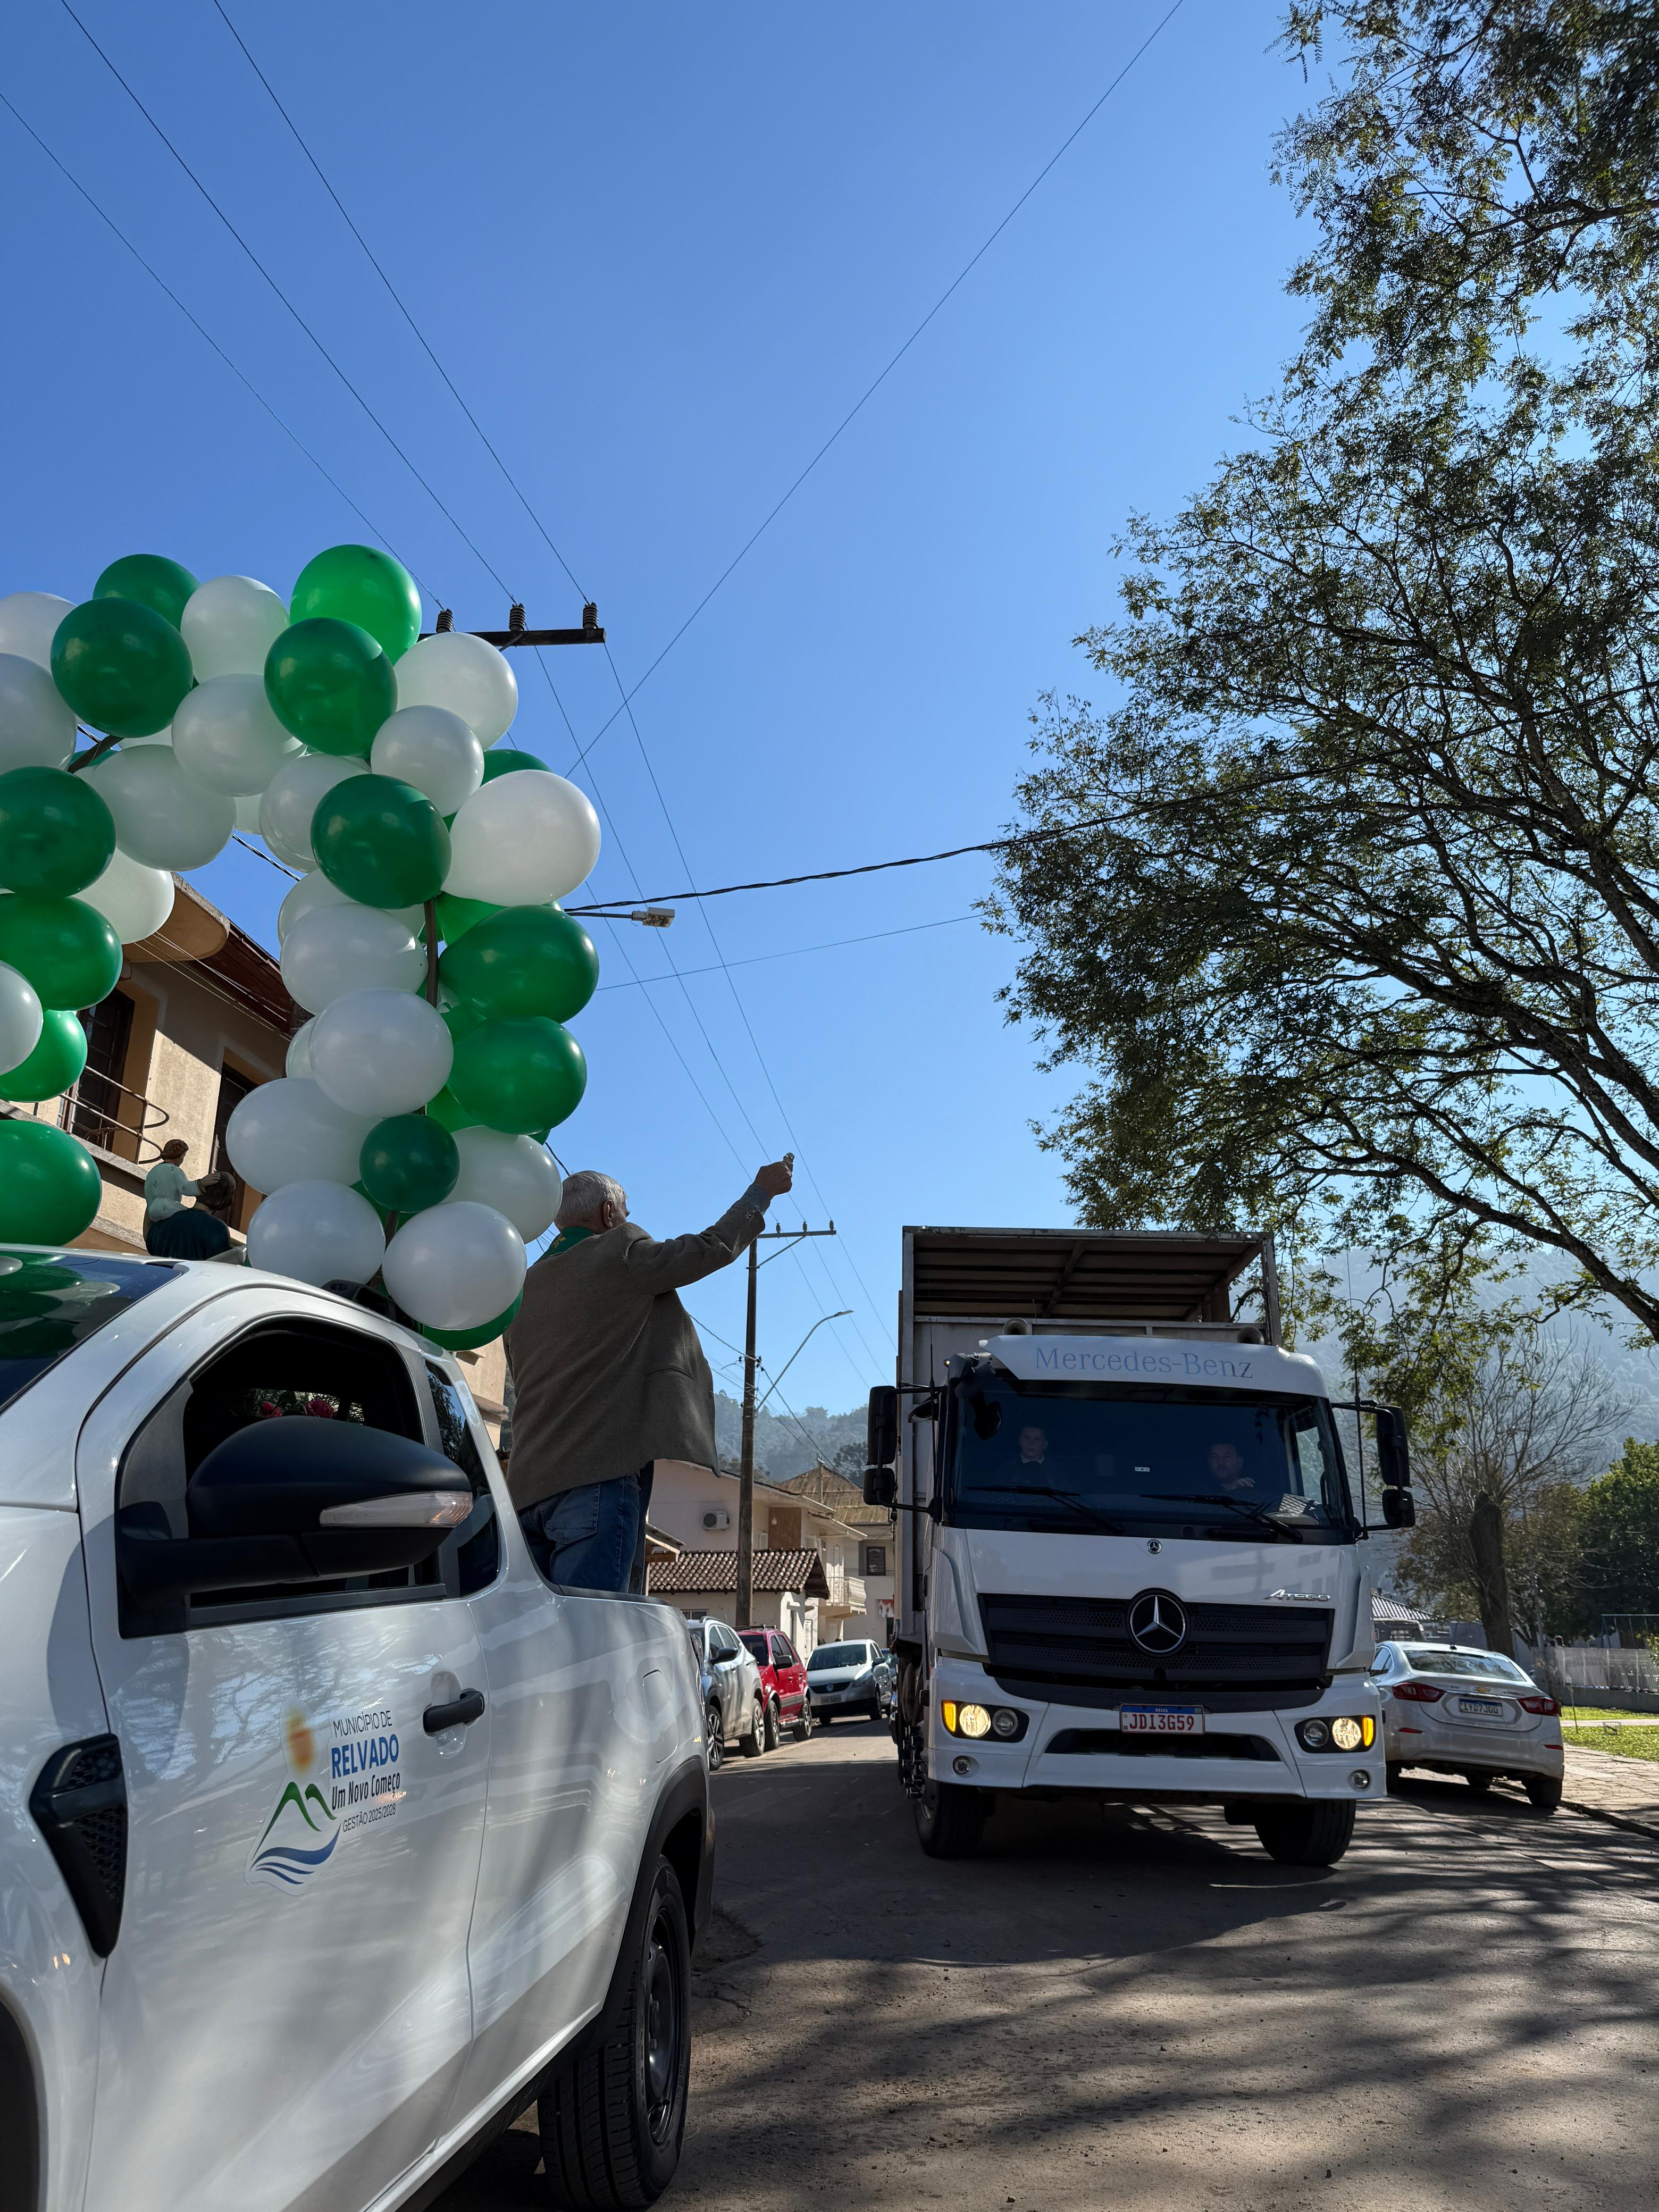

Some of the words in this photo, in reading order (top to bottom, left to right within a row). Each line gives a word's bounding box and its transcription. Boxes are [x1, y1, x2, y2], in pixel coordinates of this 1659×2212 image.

[1035, 1346, 1254, 1379] Mercedes-Benz
[333, 1712, 380, 1738] MUNICÍPIO
[380, 1710, 392, 1728] DE
[1129, 1713, 1194, 1731] JDI3G59
[331, 1734, 399, 1779] RELVADO
[332, 1786, 346, 1811] Um
[348, 1781, 369, 1805] Novo
[371, 1772, 400, 1798] Começo
[342, 1811, 368, 1832] GESTÃO
[368, 1803, 396, 1823] 2025/2028
